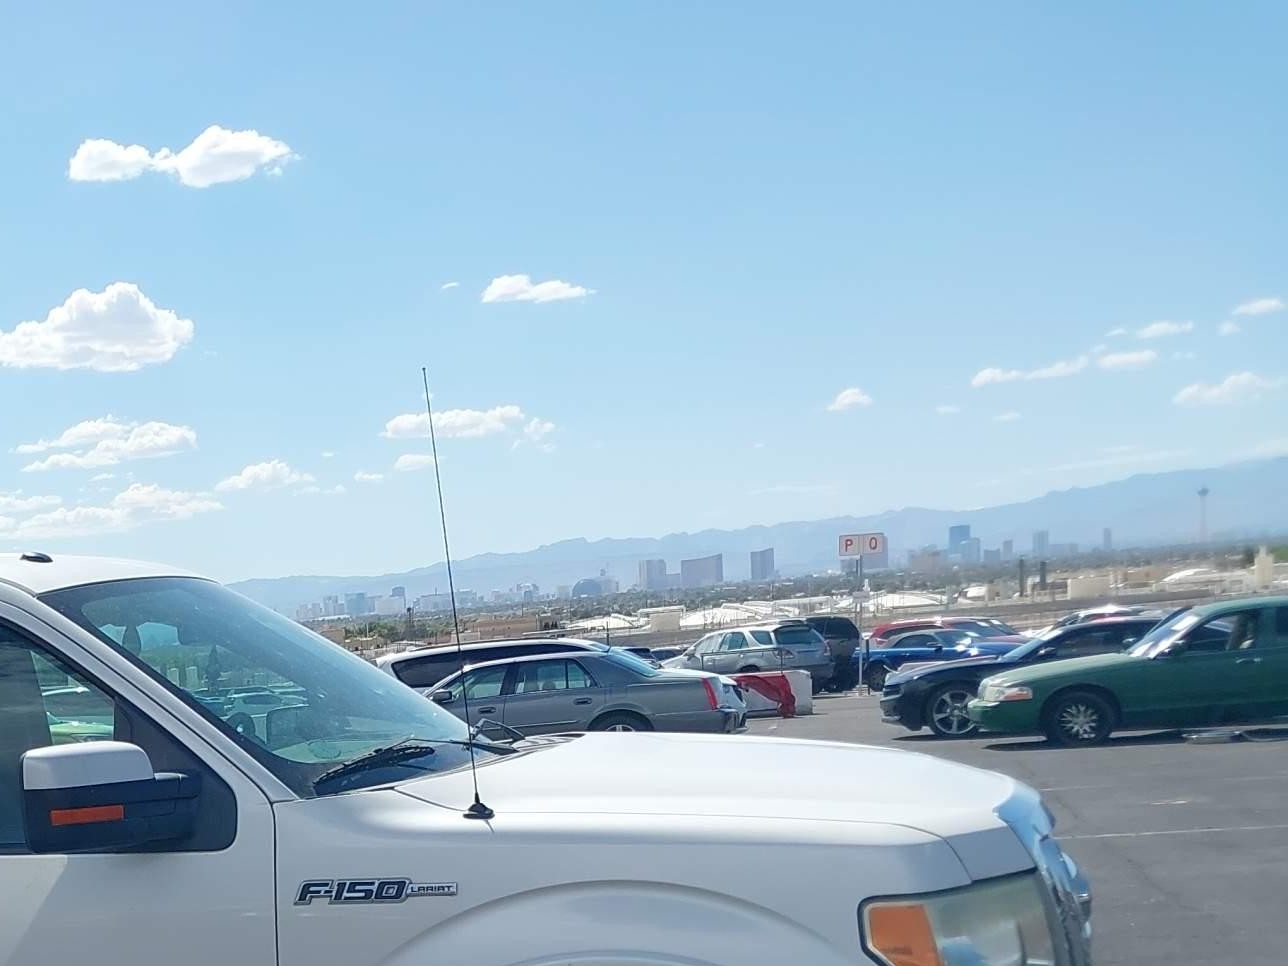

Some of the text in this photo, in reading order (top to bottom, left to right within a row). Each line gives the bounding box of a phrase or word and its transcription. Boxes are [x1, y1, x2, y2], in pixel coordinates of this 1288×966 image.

[844, 538, 854, 553] P
[295, 879, 455, 904] F-150 LARIAT
